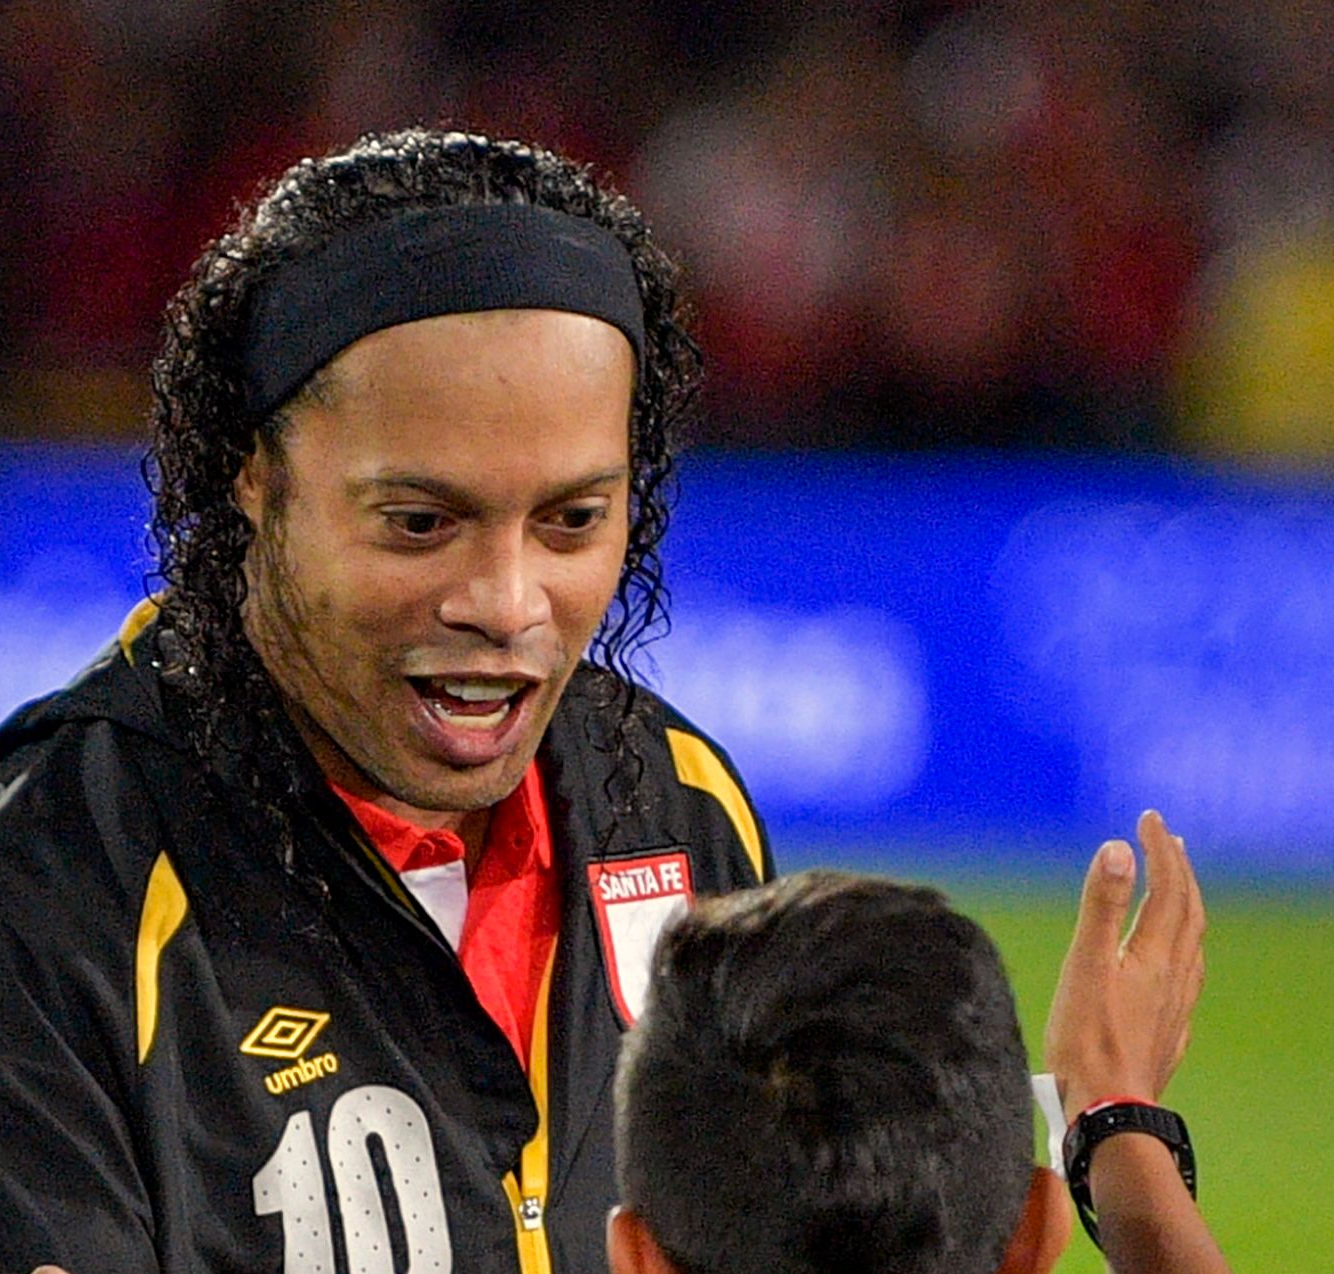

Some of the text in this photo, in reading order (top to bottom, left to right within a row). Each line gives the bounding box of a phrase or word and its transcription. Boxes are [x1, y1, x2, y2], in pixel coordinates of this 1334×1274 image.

[598, 861, 684, 900] SANTA FE
[265, 1051, 339, 1094] umbro
